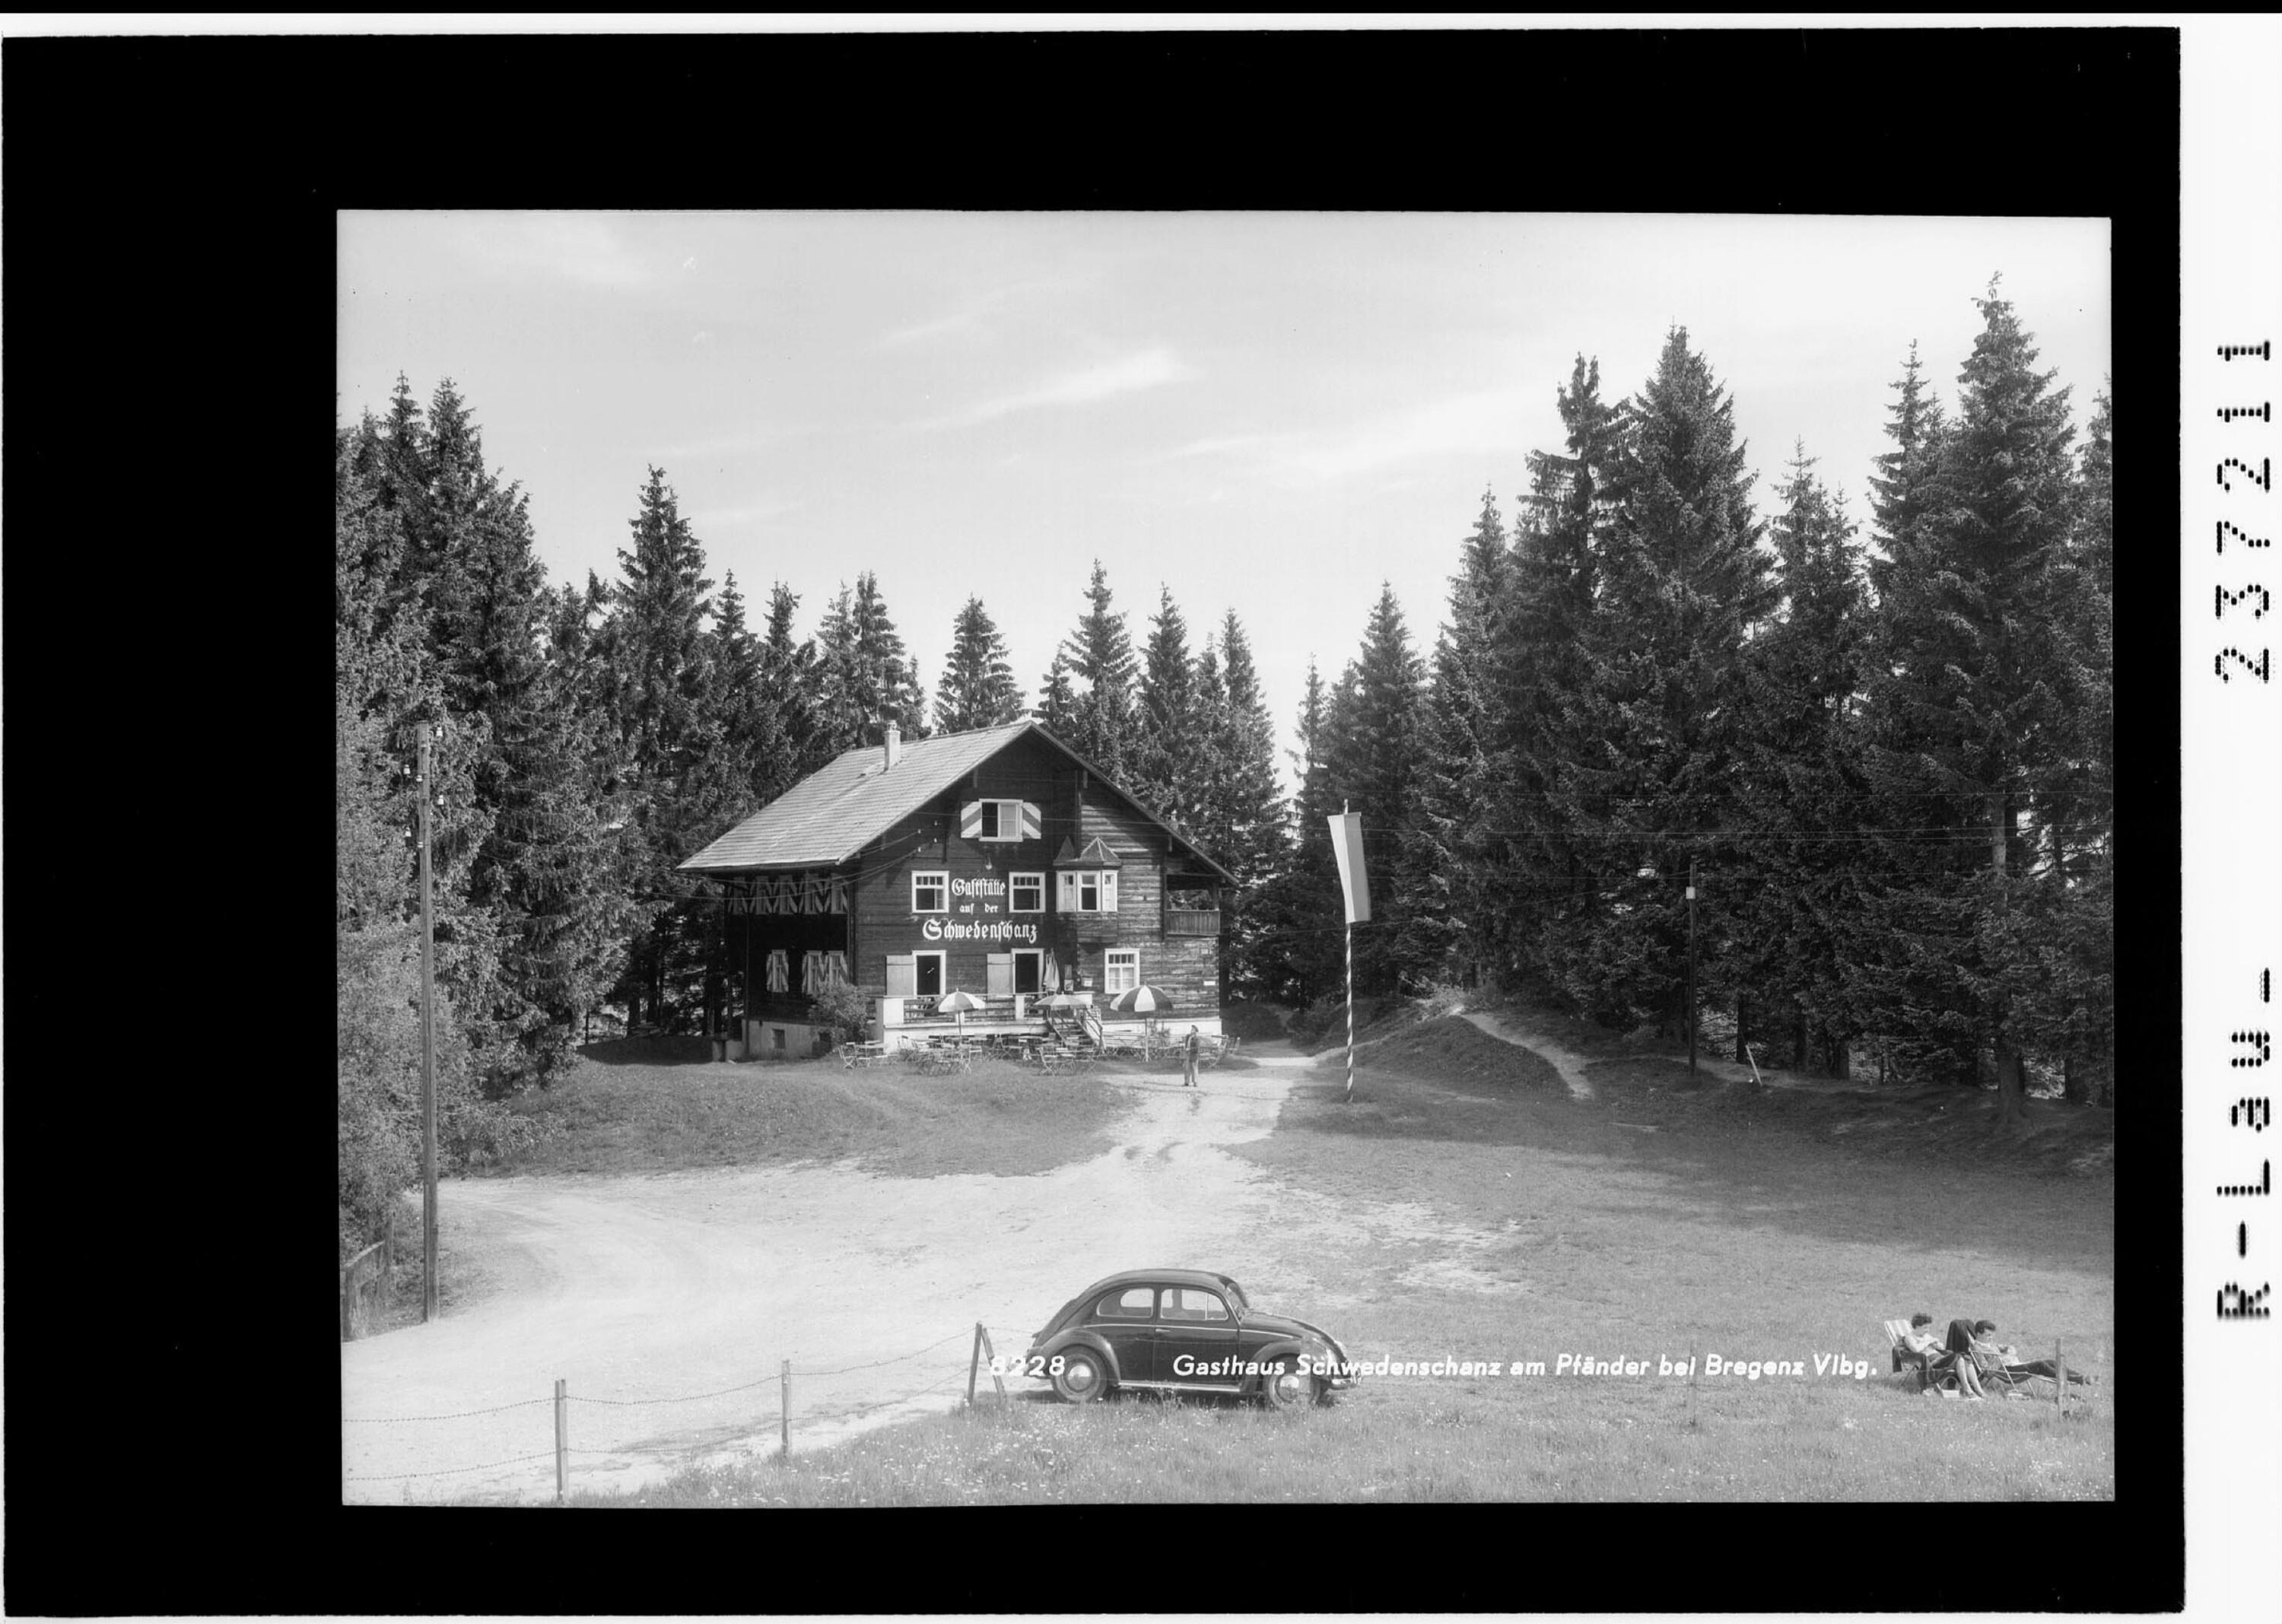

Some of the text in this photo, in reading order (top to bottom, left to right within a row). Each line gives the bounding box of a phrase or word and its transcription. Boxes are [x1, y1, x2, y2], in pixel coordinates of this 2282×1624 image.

[2215, 339, 2271, 684] 237211
[959, 903, 999, 915] auf der
[923, 919, 1038, 944] Schwedenschanz
